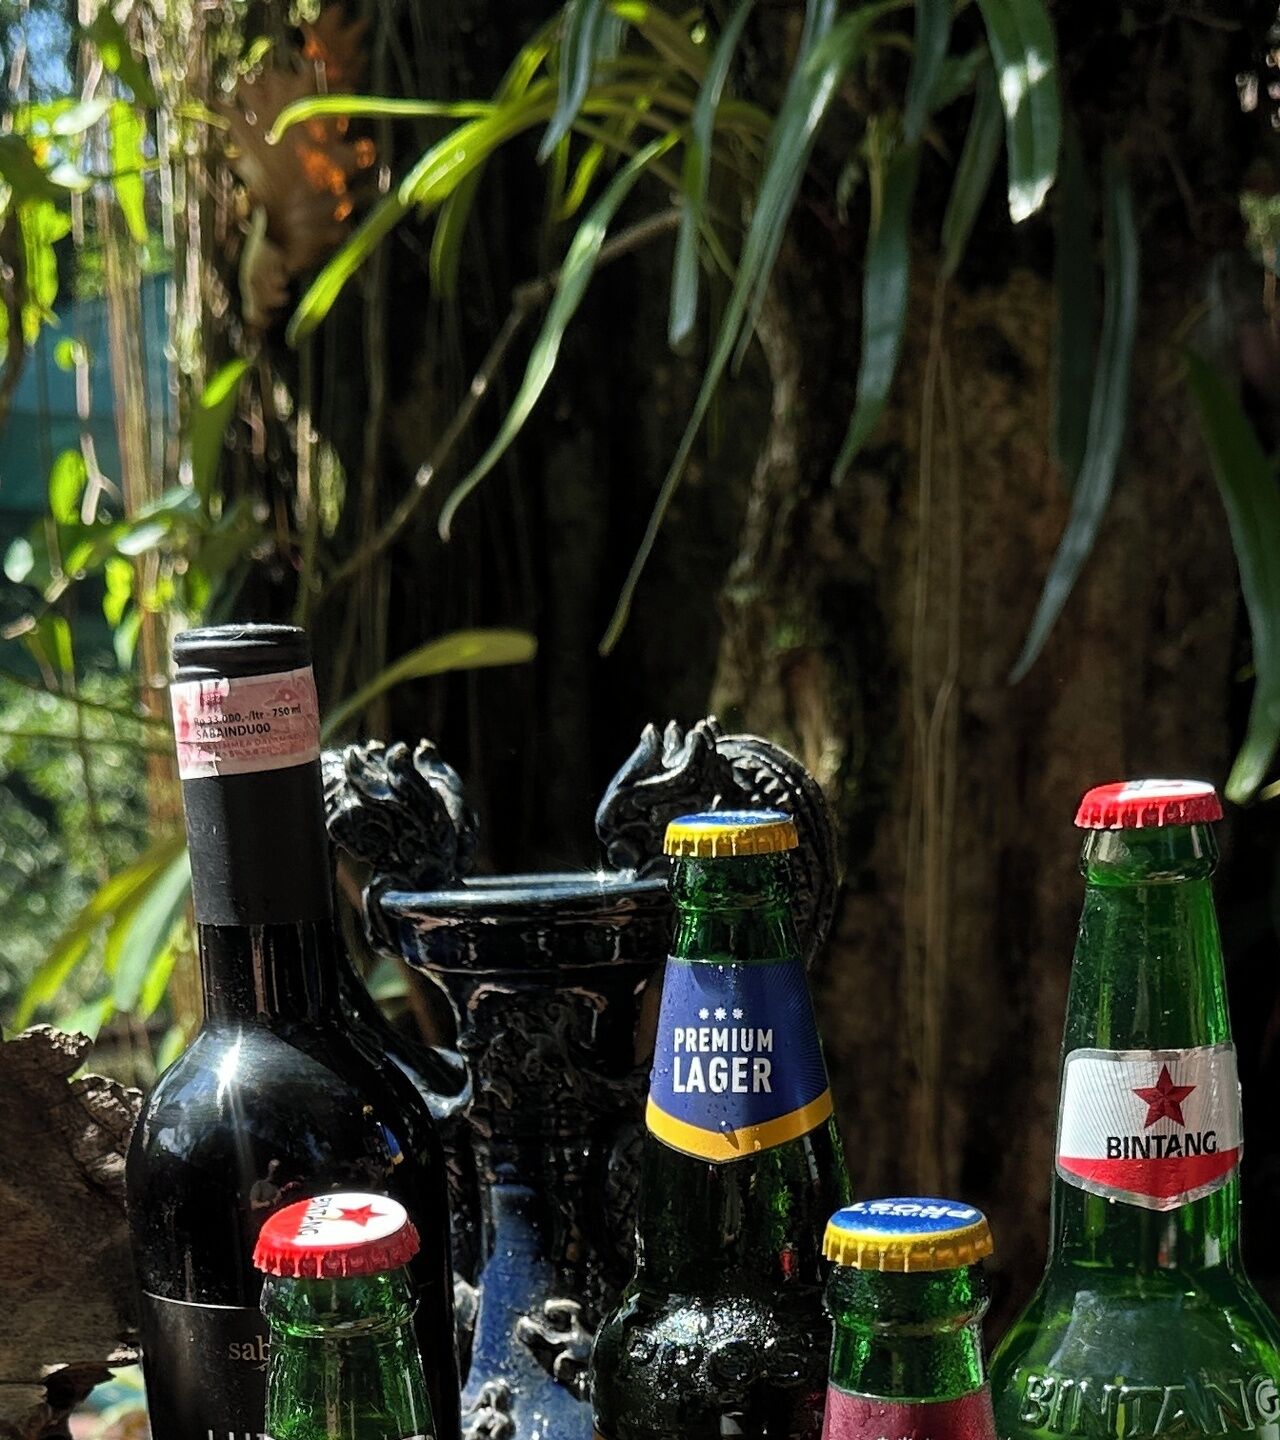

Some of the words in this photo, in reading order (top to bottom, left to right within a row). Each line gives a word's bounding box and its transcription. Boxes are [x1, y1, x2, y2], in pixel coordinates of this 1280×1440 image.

[272, 706, 290, 717] 750
[673, 1028, 773, 1053] PREMIUM
[672, 1056, 772, 1093] LAGER
[1106, 1130, 1217, 1160] BINTANG
